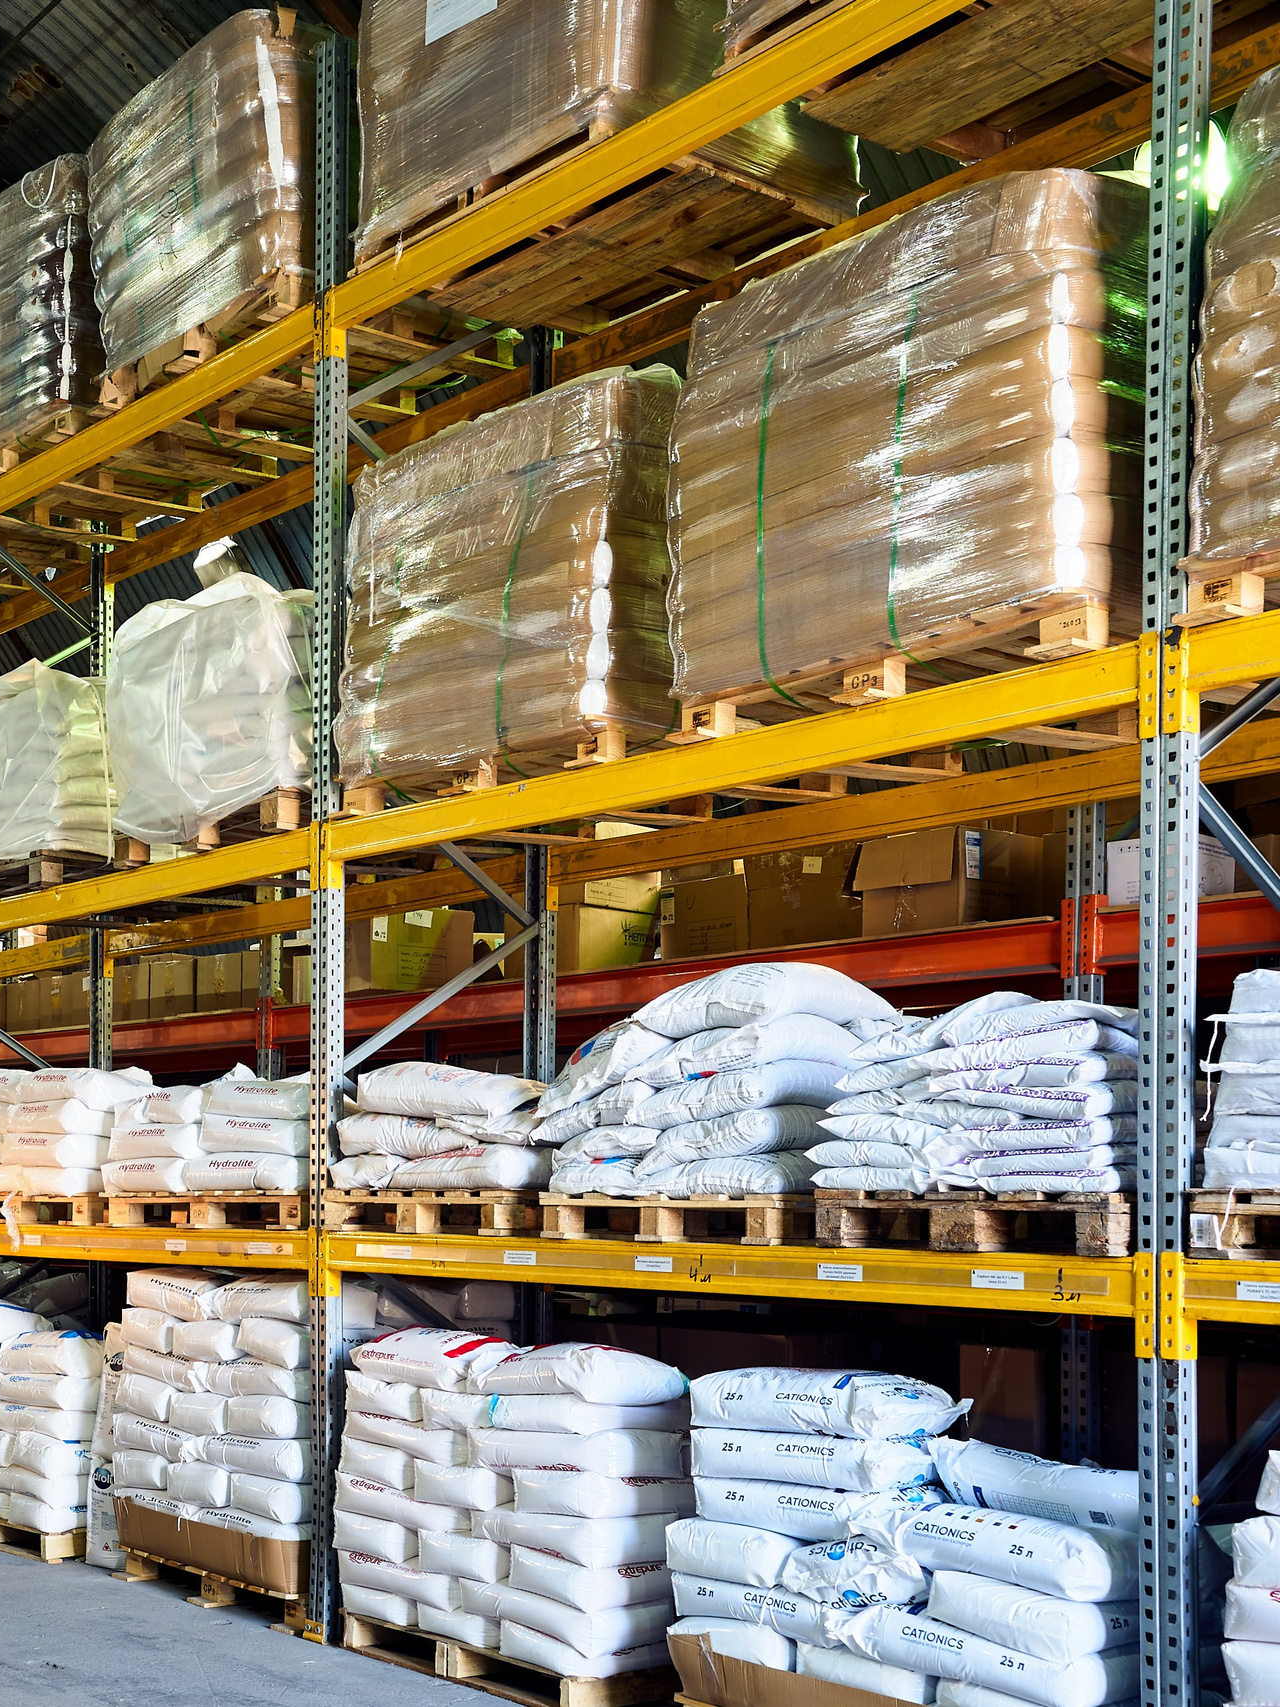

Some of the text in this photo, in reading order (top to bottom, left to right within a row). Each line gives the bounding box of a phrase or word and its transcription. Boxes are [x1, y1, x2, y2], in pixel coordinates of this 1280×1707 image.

[234, 1085, 278, 1096] Hydrolite
[226, 1119, 271, 1130] Hydrolite
[208, 1159, 254, 1170] Hydrolite
[362, 1349, 397, 1362] extrepure
[724, 1392, 736, 1400] 25
[776, 1392, 833, 1406] CATIONICS
[722, 1443, 734, 1452] 25
[776, 1444, 835, 1456] CATIONICS
[350, 1478, 387, 1494] extrepure
[725, 1491, 738, 1500] 25
[778, 1496, 834, 1511] CATIONICS
[914, 1521, 976, 1542] CATIONICS
[1009, 1544, 1024, 1556] 25
[348, 1551, 384, 1566] extrepure
[618, 1564, 664, 1578] extrepure
[697, 1586, 708, 1596] 25
[1110, 1618, 1122, 1630] 25
[902, 1626, 964, 1650] CATIONICS
[1000, 1656, 1014, 1668] 25
